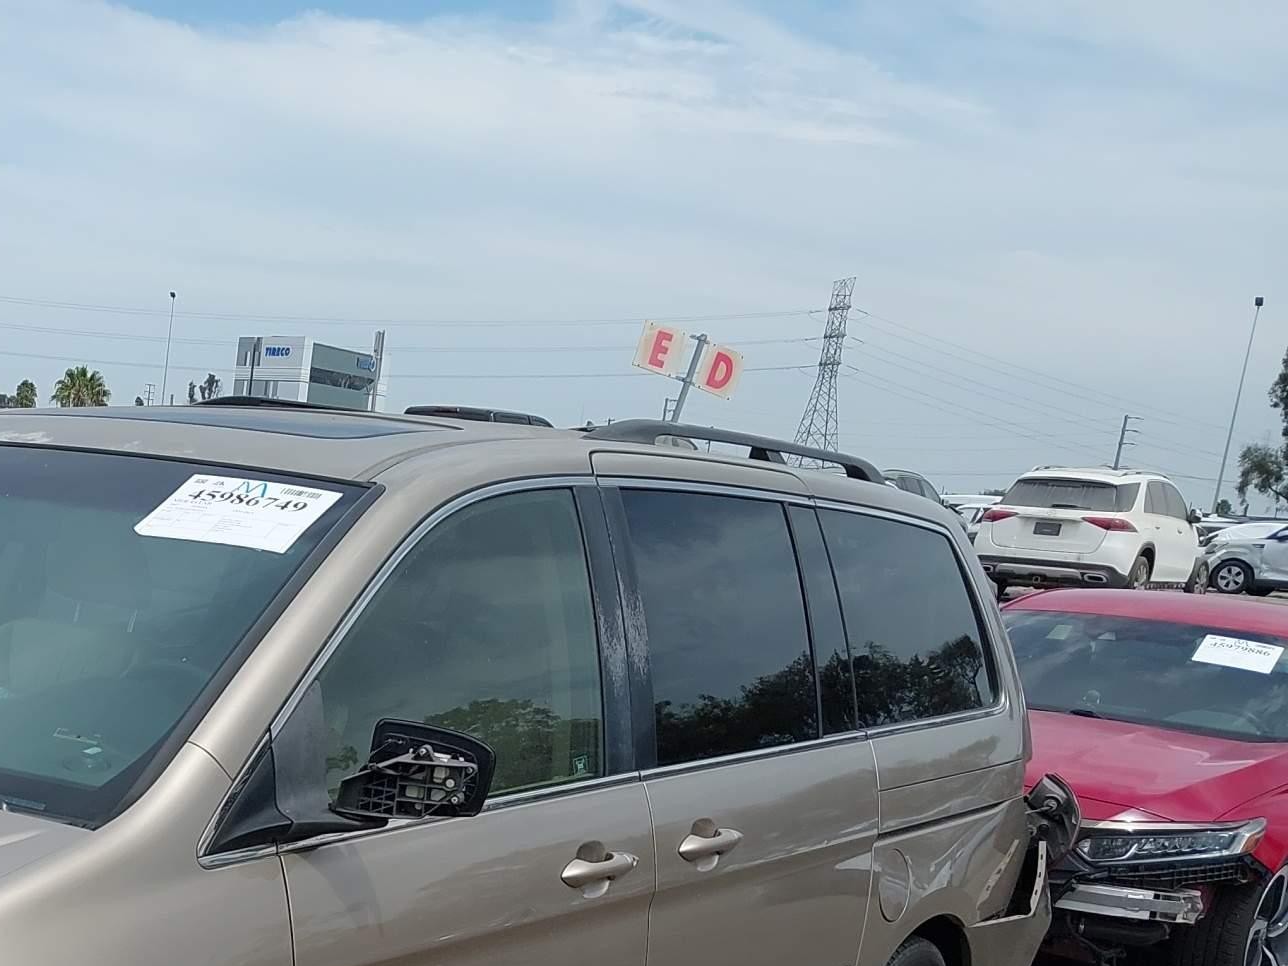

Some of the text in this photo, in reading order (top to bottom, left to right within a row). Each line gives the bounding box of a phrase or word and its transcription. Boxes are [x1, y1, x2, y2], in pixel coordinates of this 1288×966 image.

[648, 330, 673, 368] E
[705, 352, 734, 389] D
[188, 489, 309, 513] 45986749
